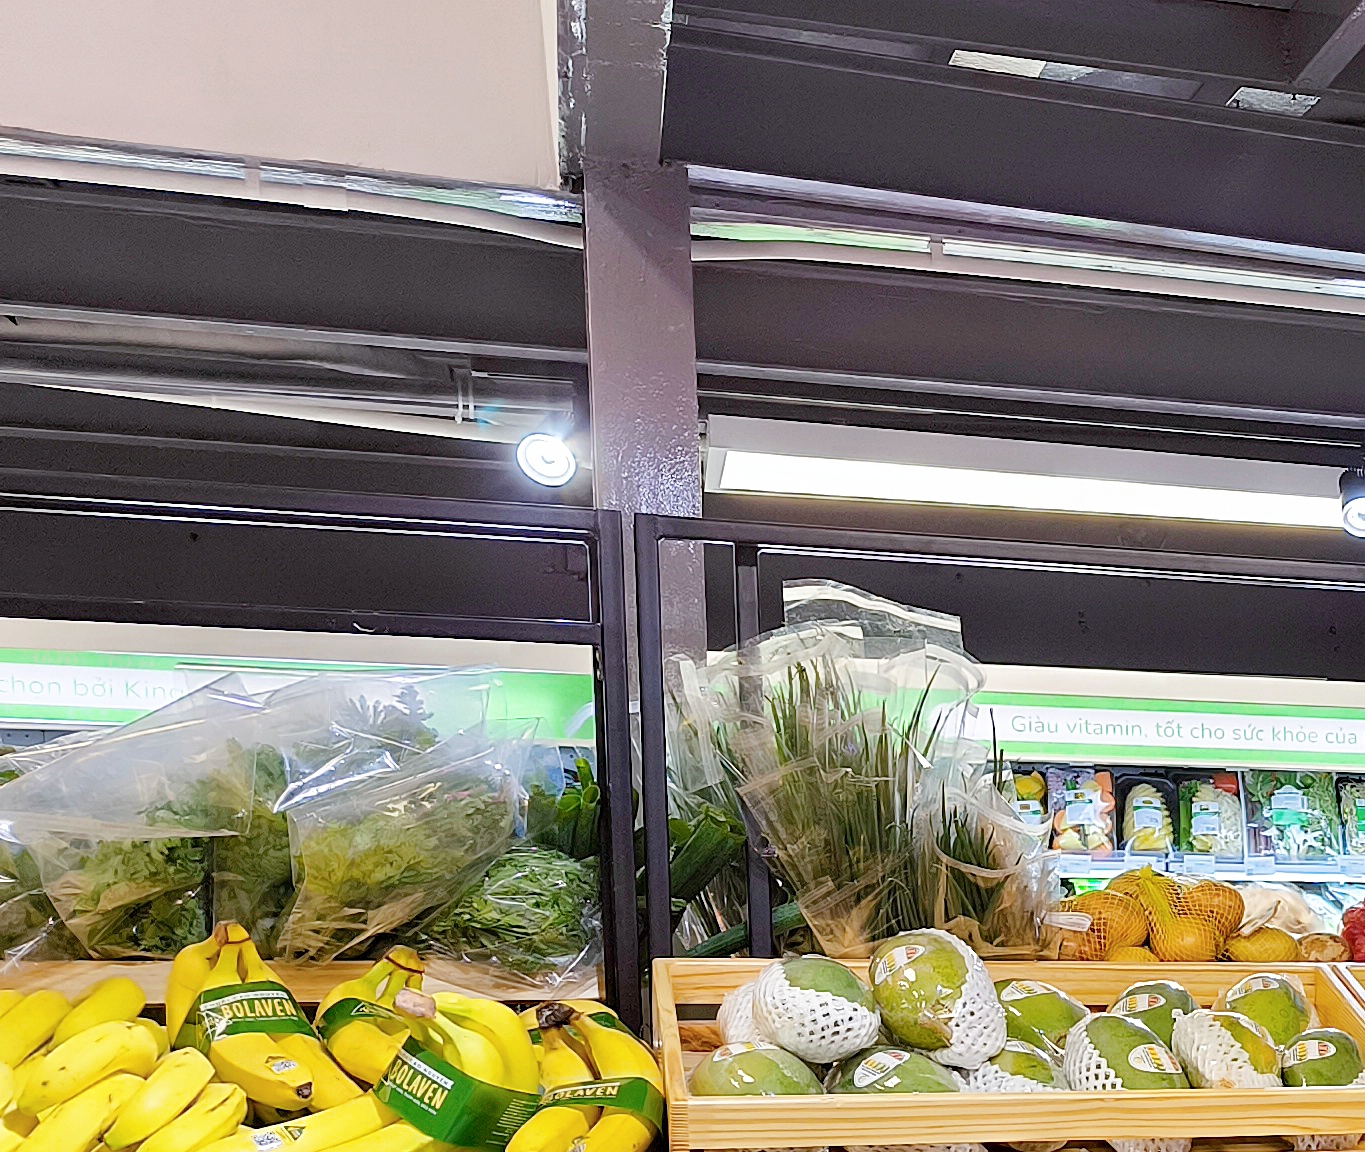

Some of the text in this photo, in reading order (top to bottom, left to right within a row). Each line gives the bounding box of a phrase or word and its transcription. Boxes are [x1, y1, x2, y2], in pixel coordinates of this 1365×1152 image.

[1011, 715, 1059, 735] Giàu
[1155, 719, 1183, 740] tốt
[1189, 722, 1226, 741] cho
[1231, 722, 1265, 742] sức
[1271, 724, 1319, 744] khỏe
[1325, 727, 1358, 746] của
[220, 997, 298, 1020] BOLAVEN
[389, 1058, 449, 1111] BOLAVEN
